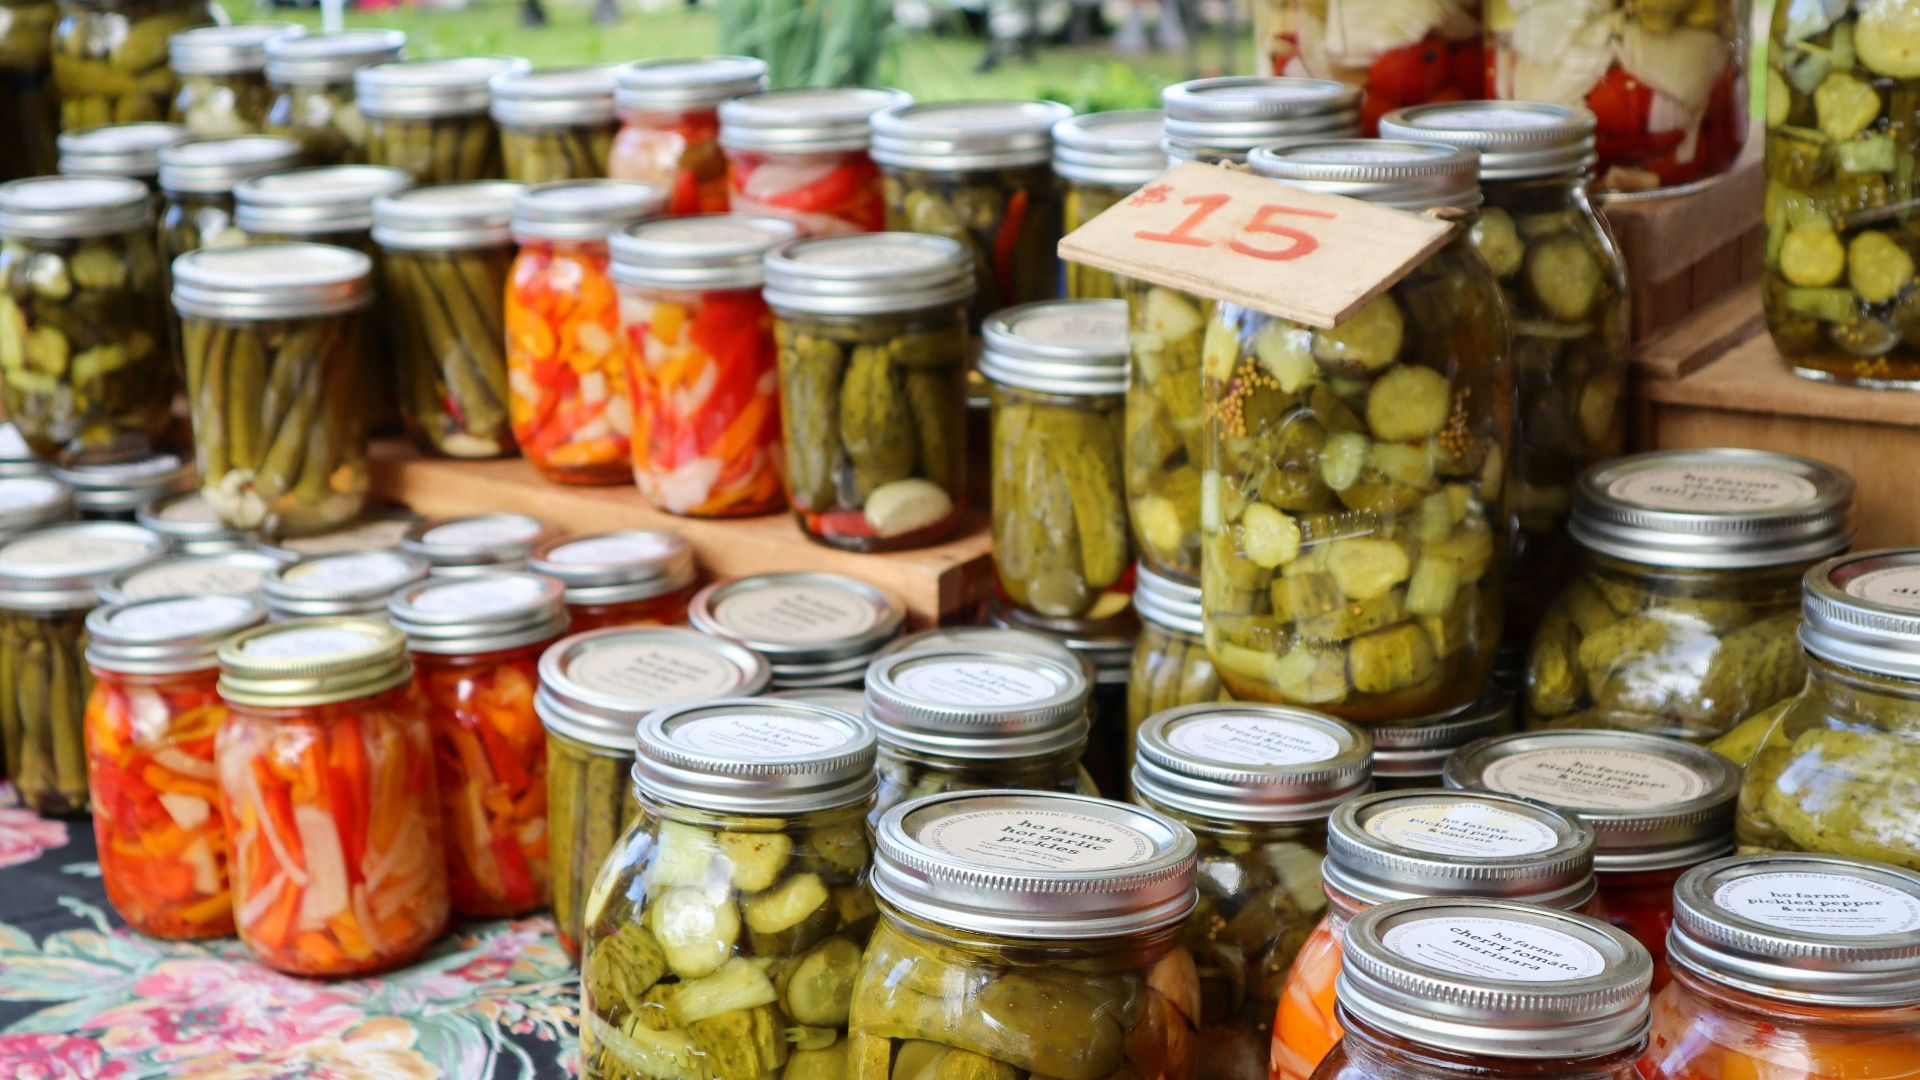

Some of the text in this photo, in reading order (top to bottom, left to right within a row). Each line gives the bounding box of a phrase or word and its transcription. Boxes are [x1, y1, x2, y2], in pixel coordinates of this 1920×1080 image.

[1127, 183, 1337, 261] $15
[1000, 826, 1107, 851] hot garlic
[1018, 820, 1115, 844] ho farms
[1408, 817, 1469, 833] pickled
[1470, 830, 1527, 843] pepper
[1440, 831, 1493, 843] onions
[1462, 822, 1509, 834] farms
[996, 835, 1081, 855] pickles
[1747, 898, 1815, 906] pickled
[1449, 927, 1511, 951] cherry
[1512, 948, 1579, 972] tomato
[1451, 938, 1541, 971] marinara
[1491, 932, 1513, 943] ho
[1513, 939, 1563, 958] farms
